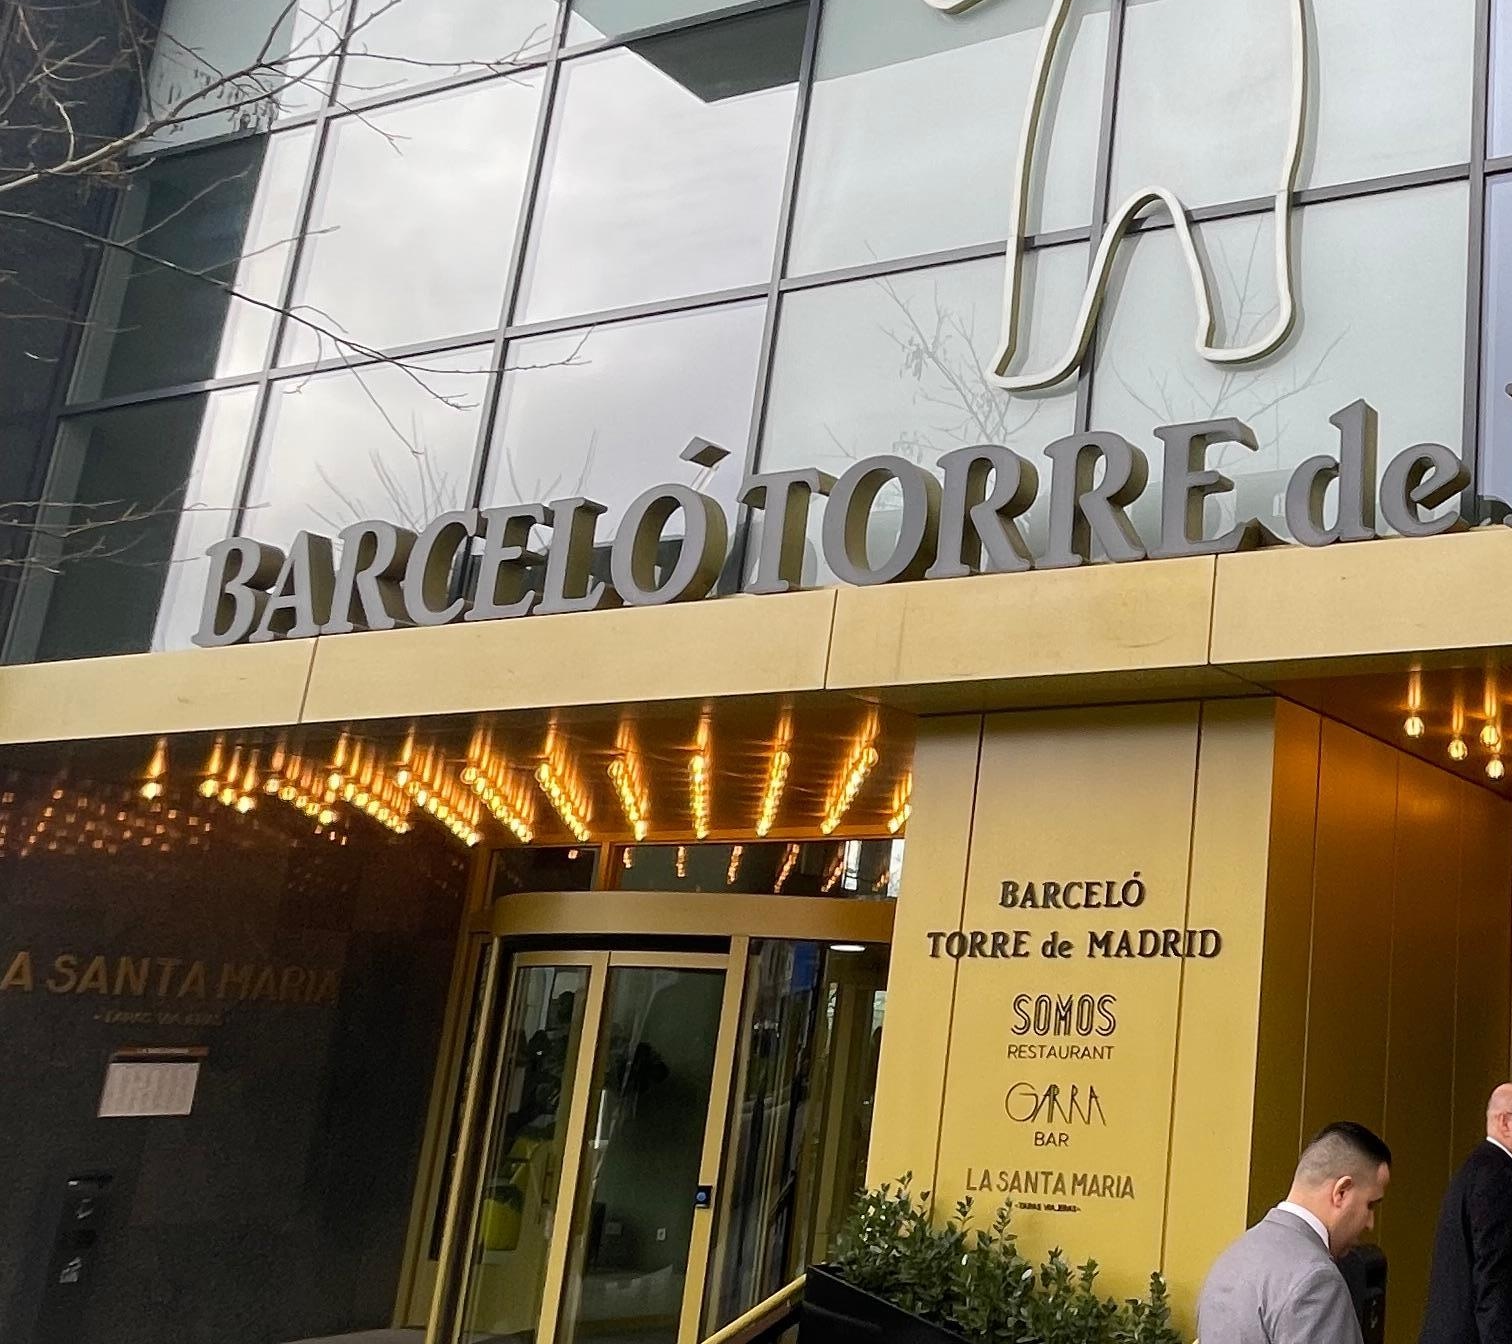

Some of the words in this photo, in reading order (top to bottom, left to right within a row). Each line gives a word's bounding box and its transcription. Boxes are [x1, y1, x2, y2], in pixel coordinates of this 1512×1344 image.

[192, 436, 730, 649] BARCELÓ
[738, 418, 1262, 596] TORRE
[1283, 398, 1471, 547] de
[998, 871, 1146, 909] BARCELÓ
[927, 930, 1031, 959] TORRE
[1041, 931, 1074, 959] de
[1086, 928, 1223, 959] MADRID
[46, 953, 207, 1000] SANTA
[217, 960, 340, 1005] MARIA
[1010, 993, 1118, 1037] SOMOS
[1007, 1044, 1115, 1060] RESTAURANT
[1005, 1082, 1107, 1127] GARRA
[1033, 1131, 1070, 1147] BAR
[965, 1167, 993, 1193] LA
[996, 1169, 1067, 1196] SANTA
[1071, 1171, 1136, 1200] MARIA
